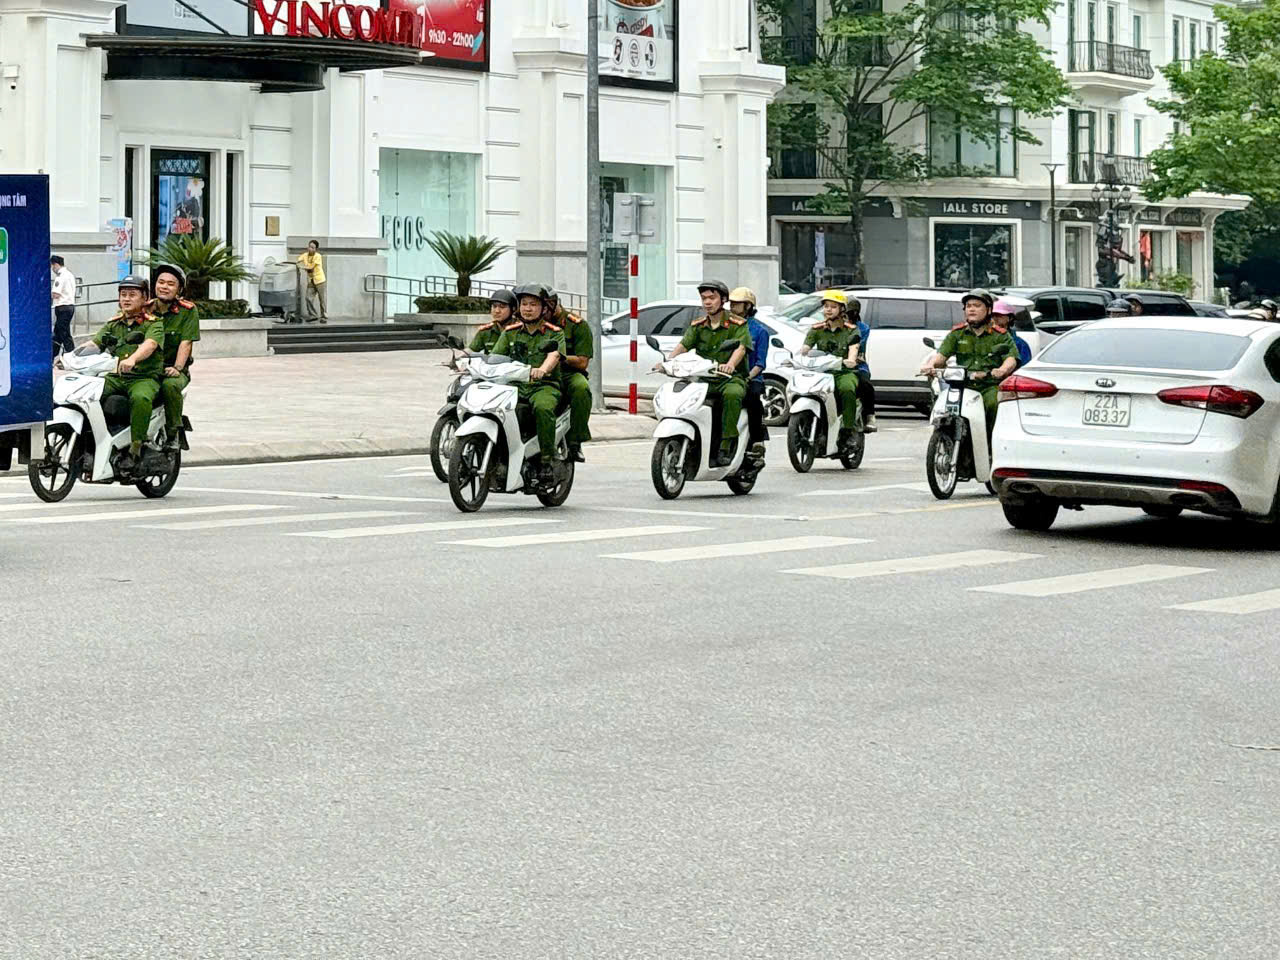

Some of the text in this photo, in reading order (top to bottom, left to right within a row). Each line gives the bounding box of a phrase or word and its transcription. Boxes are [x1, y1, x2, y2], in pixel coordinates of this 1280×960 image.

[428, 29, 446, 44] 9h30
[452, 31, 474, 48] 22h00
[972, 203, 1008, 214] STORE
[1095, 394, 1118, 409] 22A
[1084, 409, 1127, 424] 083.37
